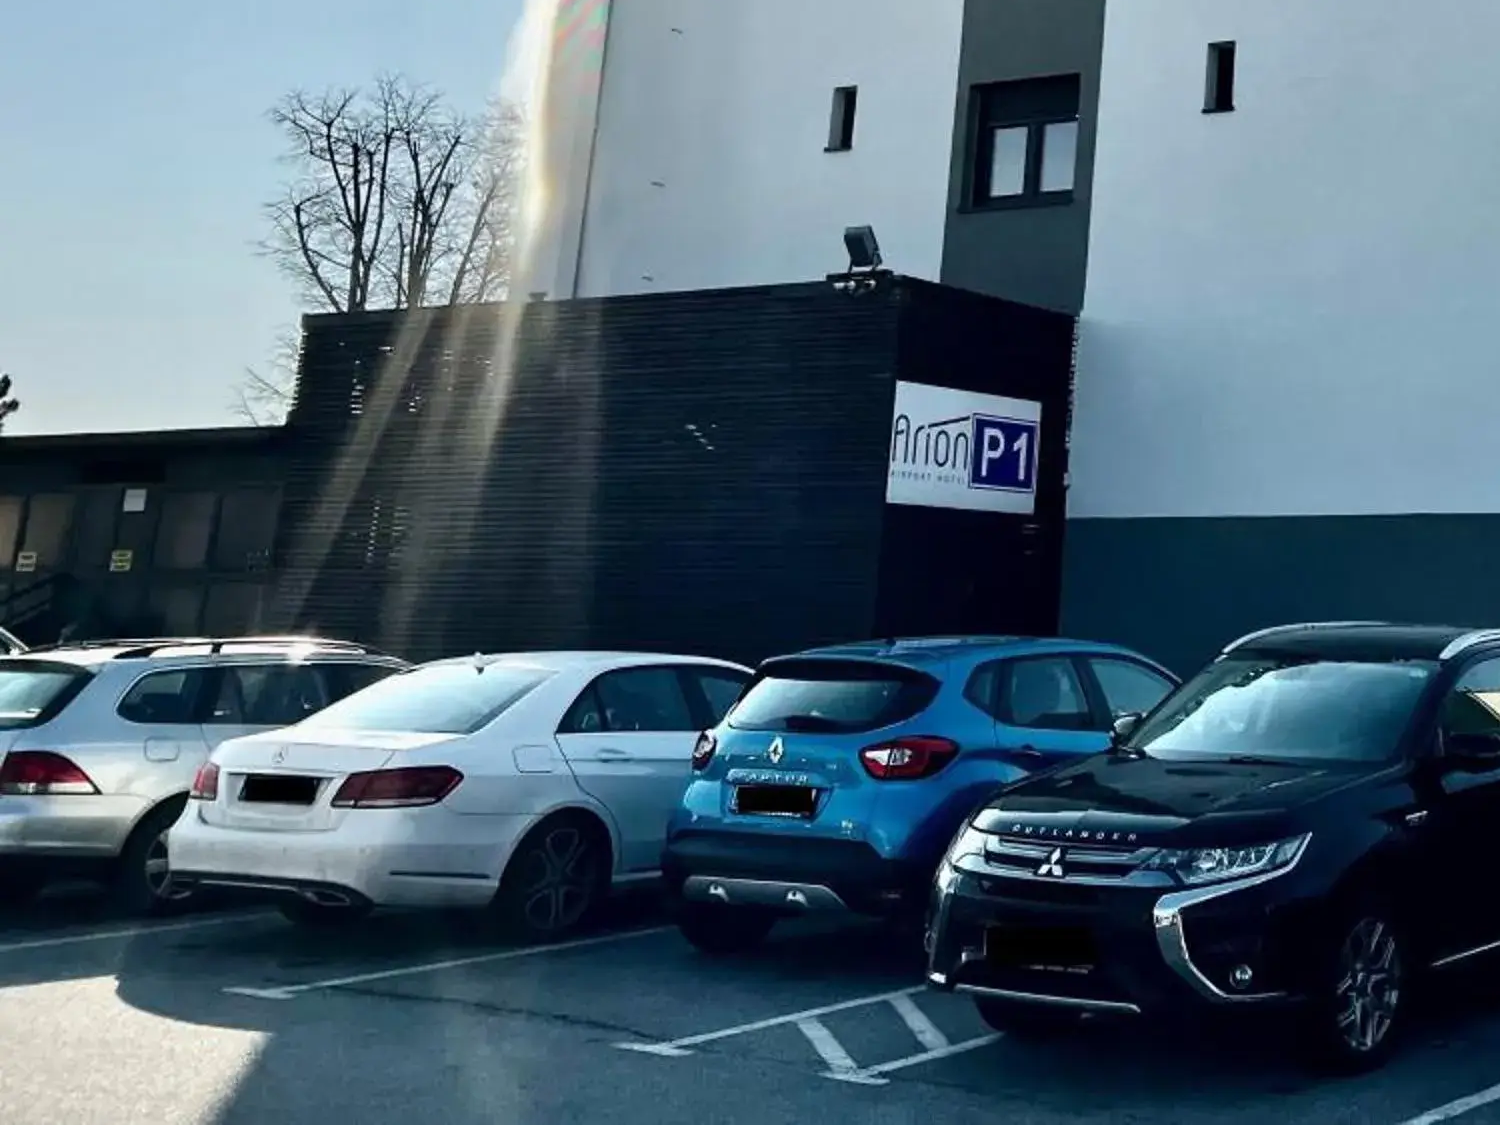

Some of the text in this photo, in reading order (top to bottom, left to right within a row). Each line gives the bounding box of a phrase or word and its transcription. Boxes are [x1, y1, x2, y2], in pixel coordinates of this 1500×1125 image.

[892, 413, 970, 471] Arion
[980, 426, 1029, 481] P1
[1012, 824, 1137, 841] OUTLANDER
